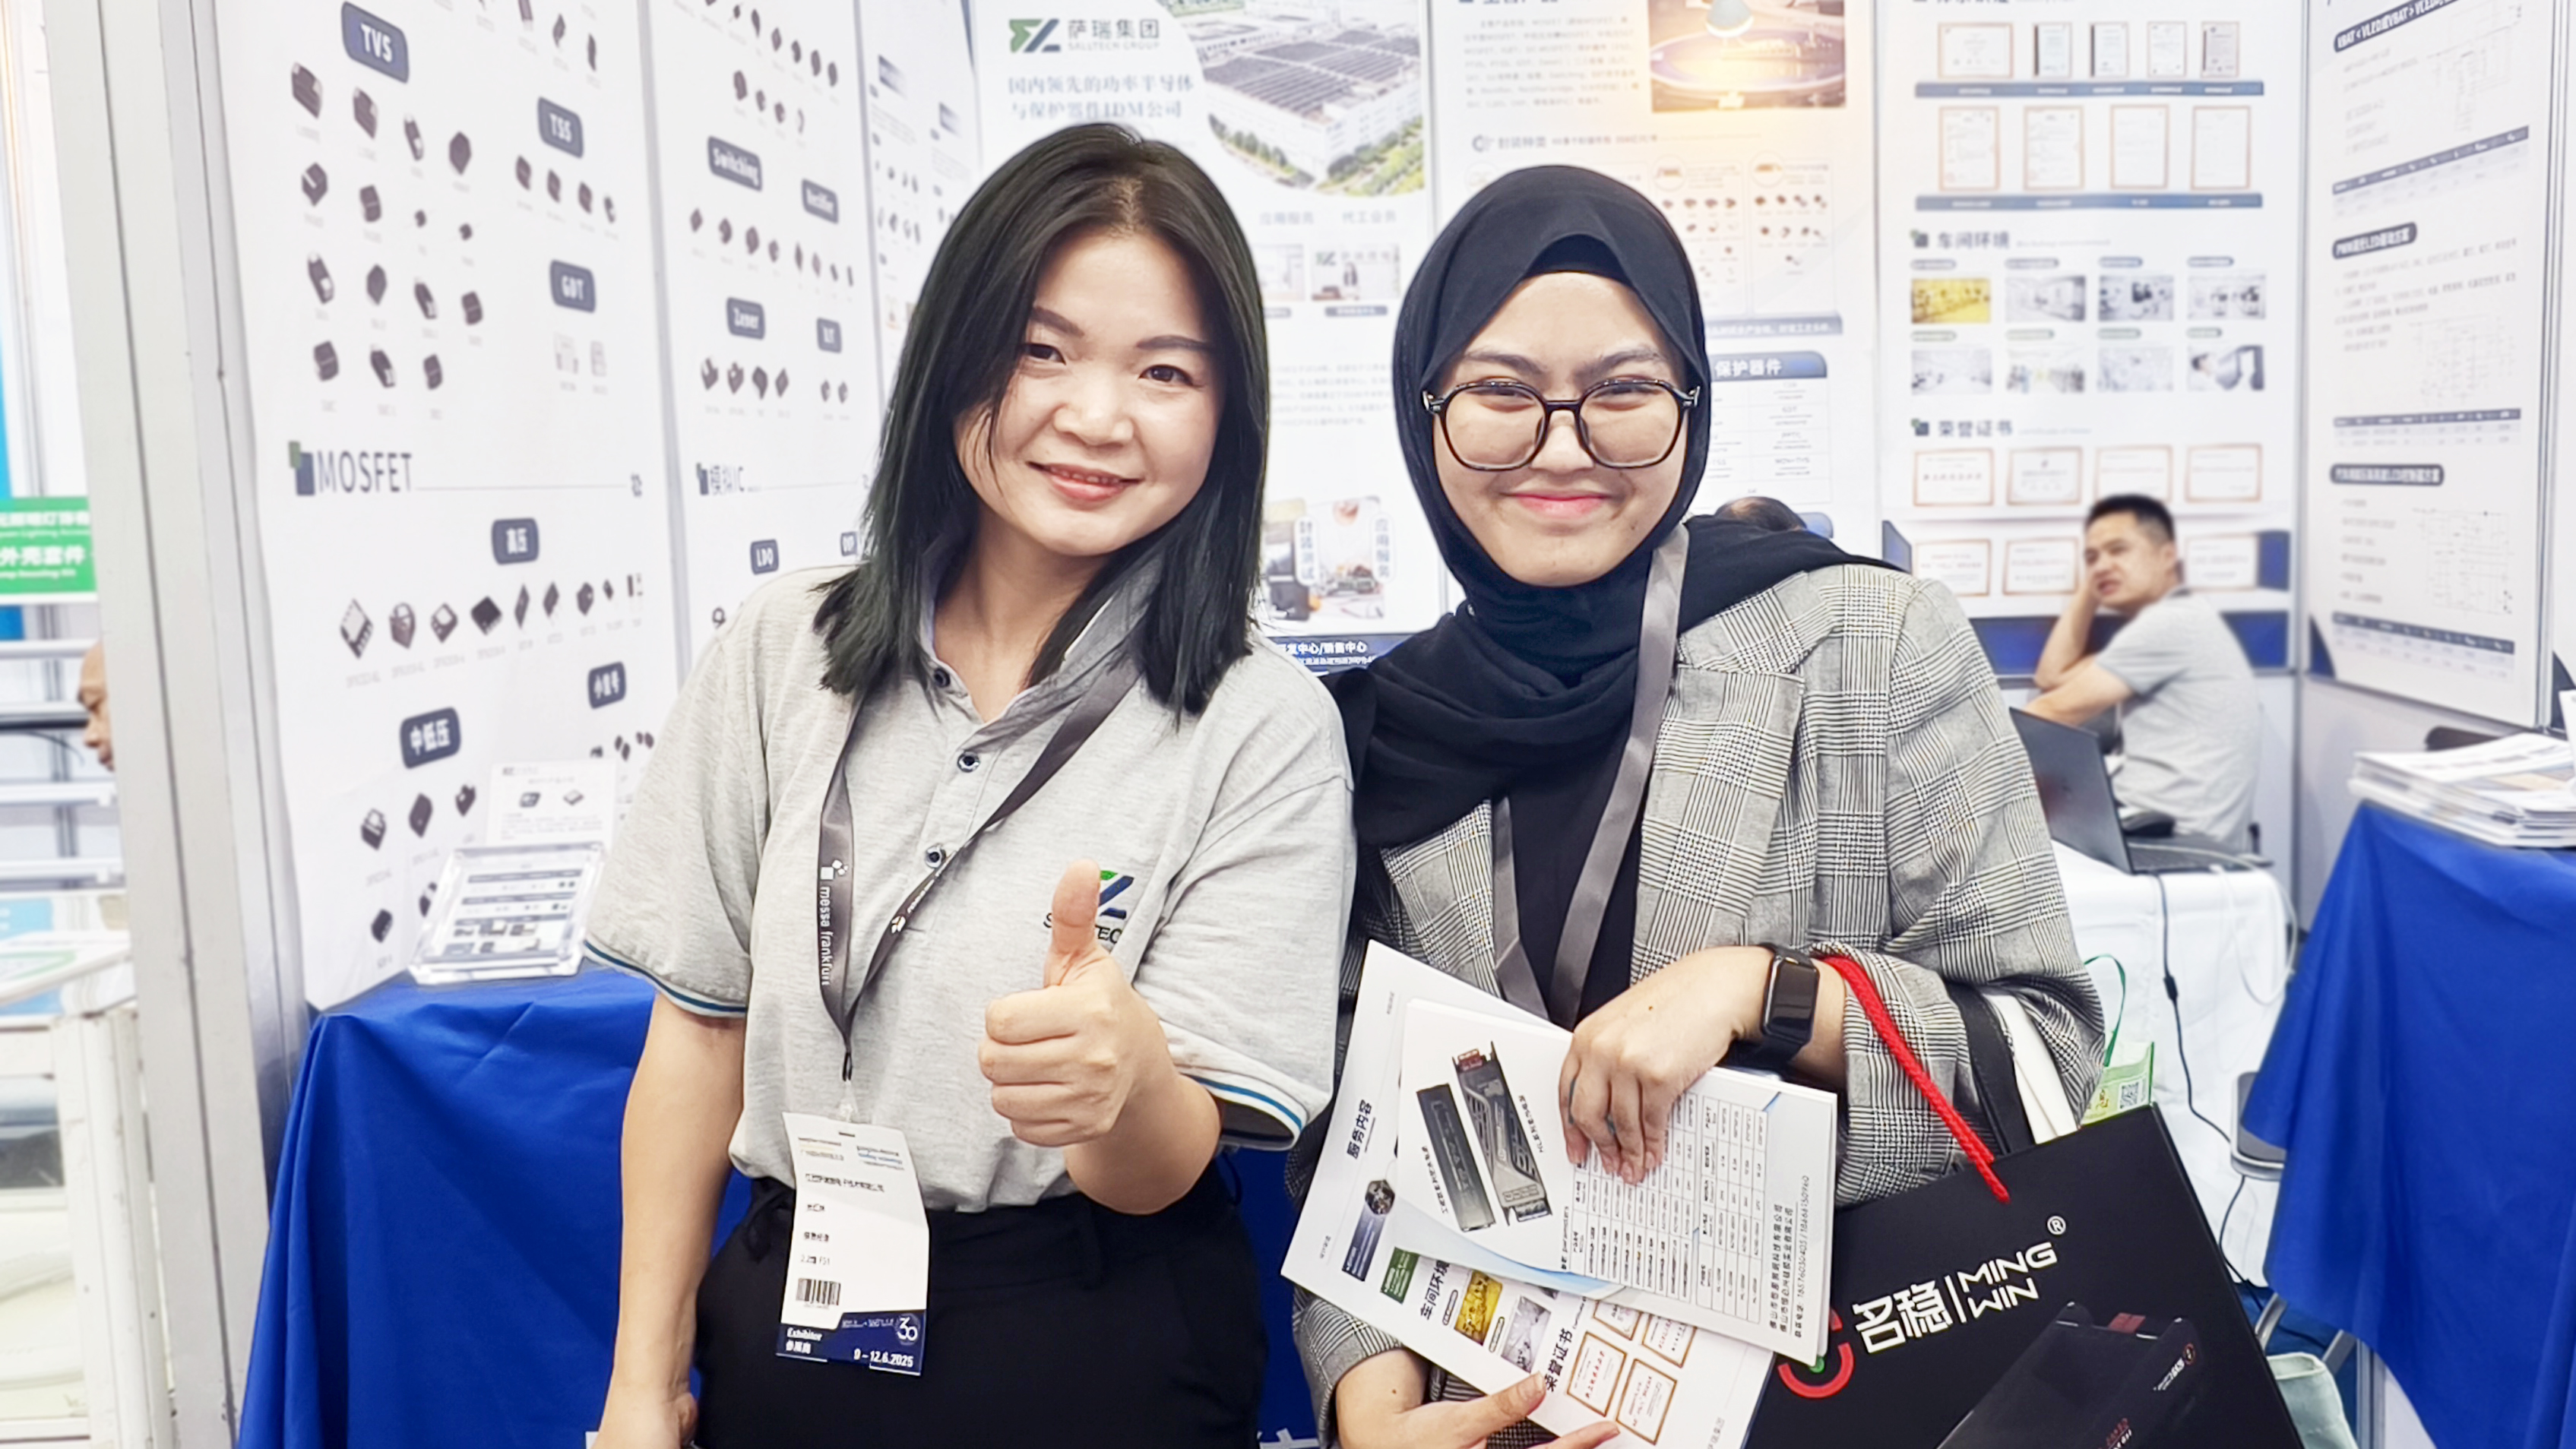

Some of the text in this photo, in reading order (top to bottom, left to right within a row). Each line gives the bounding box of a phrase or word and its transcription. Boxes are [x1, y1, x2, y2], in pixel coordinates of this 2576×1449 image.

[360, 23, 393, 63] TVS
[1068, 19, 1159, 39] 萨瑞集团
[1009, 74, 1193, 94] 国内领先的功率半导体
[1012, 100, 1182, 119] 与保护器件IDM公司
[549, 112, 572, 142] TSS
[714, 148, 760, 185] Switching
[1937, 231, 2011, 249] 车间环境
[562, 276, 585, 301] GDT
[1714, 359, 1782, 377] 保护器件
[1938, 419, 2013, 437] 荣誉证书
[318, 450, 413, 494] MOSFET
[756, 547, 774, 568] LDO
[410, 719, 451, 755] 中低压
[820, 886, 831, 928] messe
[1347, 1099, 1374, 1159] 服务内容
[1957, 1241, 2058, 1292] MING
[1967, 1277, 2040, 1318] WIN
[869, 1350, 914, 1368] 12.6.2025
[1544, 1327, 1574, 1392] 荣誉证书
